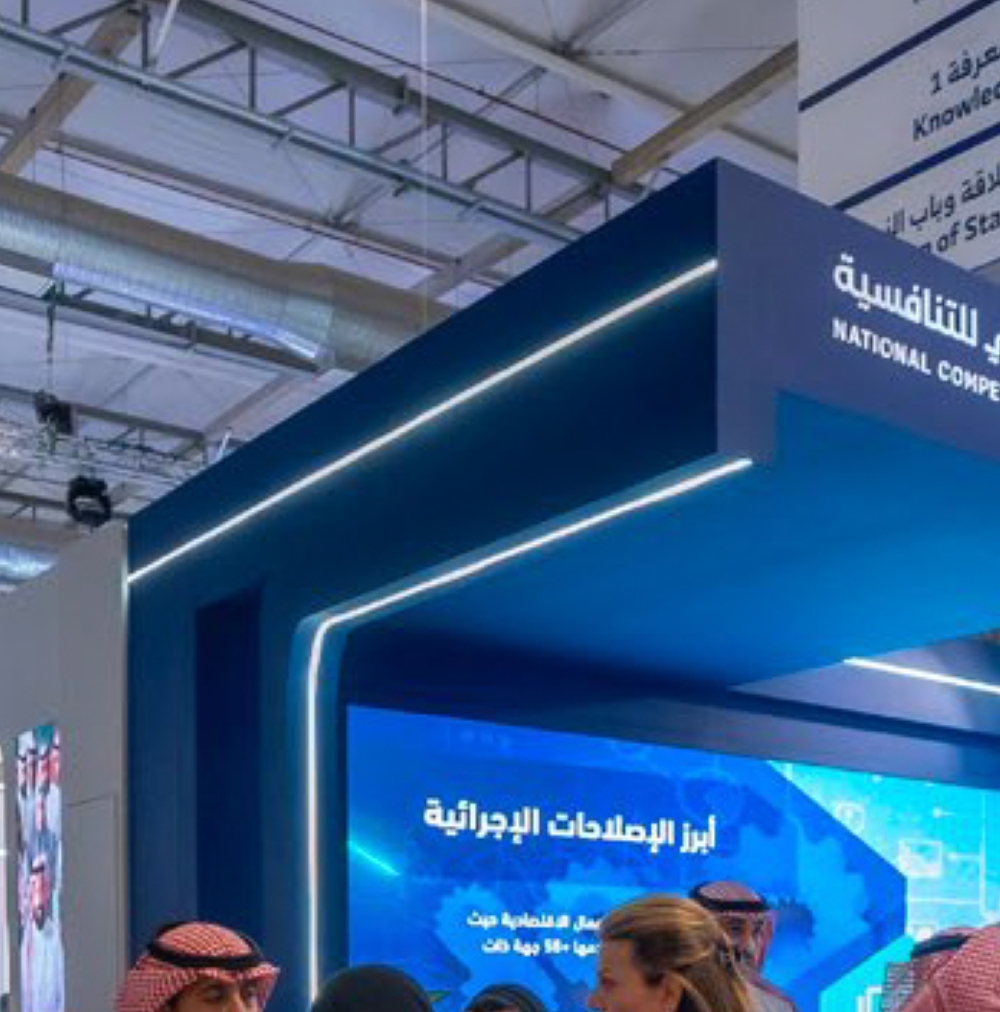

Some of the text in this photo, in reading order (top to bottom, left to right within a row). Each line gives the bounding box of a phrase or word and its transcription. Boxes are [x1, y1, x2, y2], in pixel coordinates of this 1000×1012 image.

[930, 70, 942, 95] 1
[909, 194, 956, 232] وباب
[936, 219, 960, 253] of
[833, 252, 978, 347] للتنافسية
[832, 316, 932, 376] NATIONAL
[423, 797, 716, 856] أبرز الإصلاحات الإجرائية
